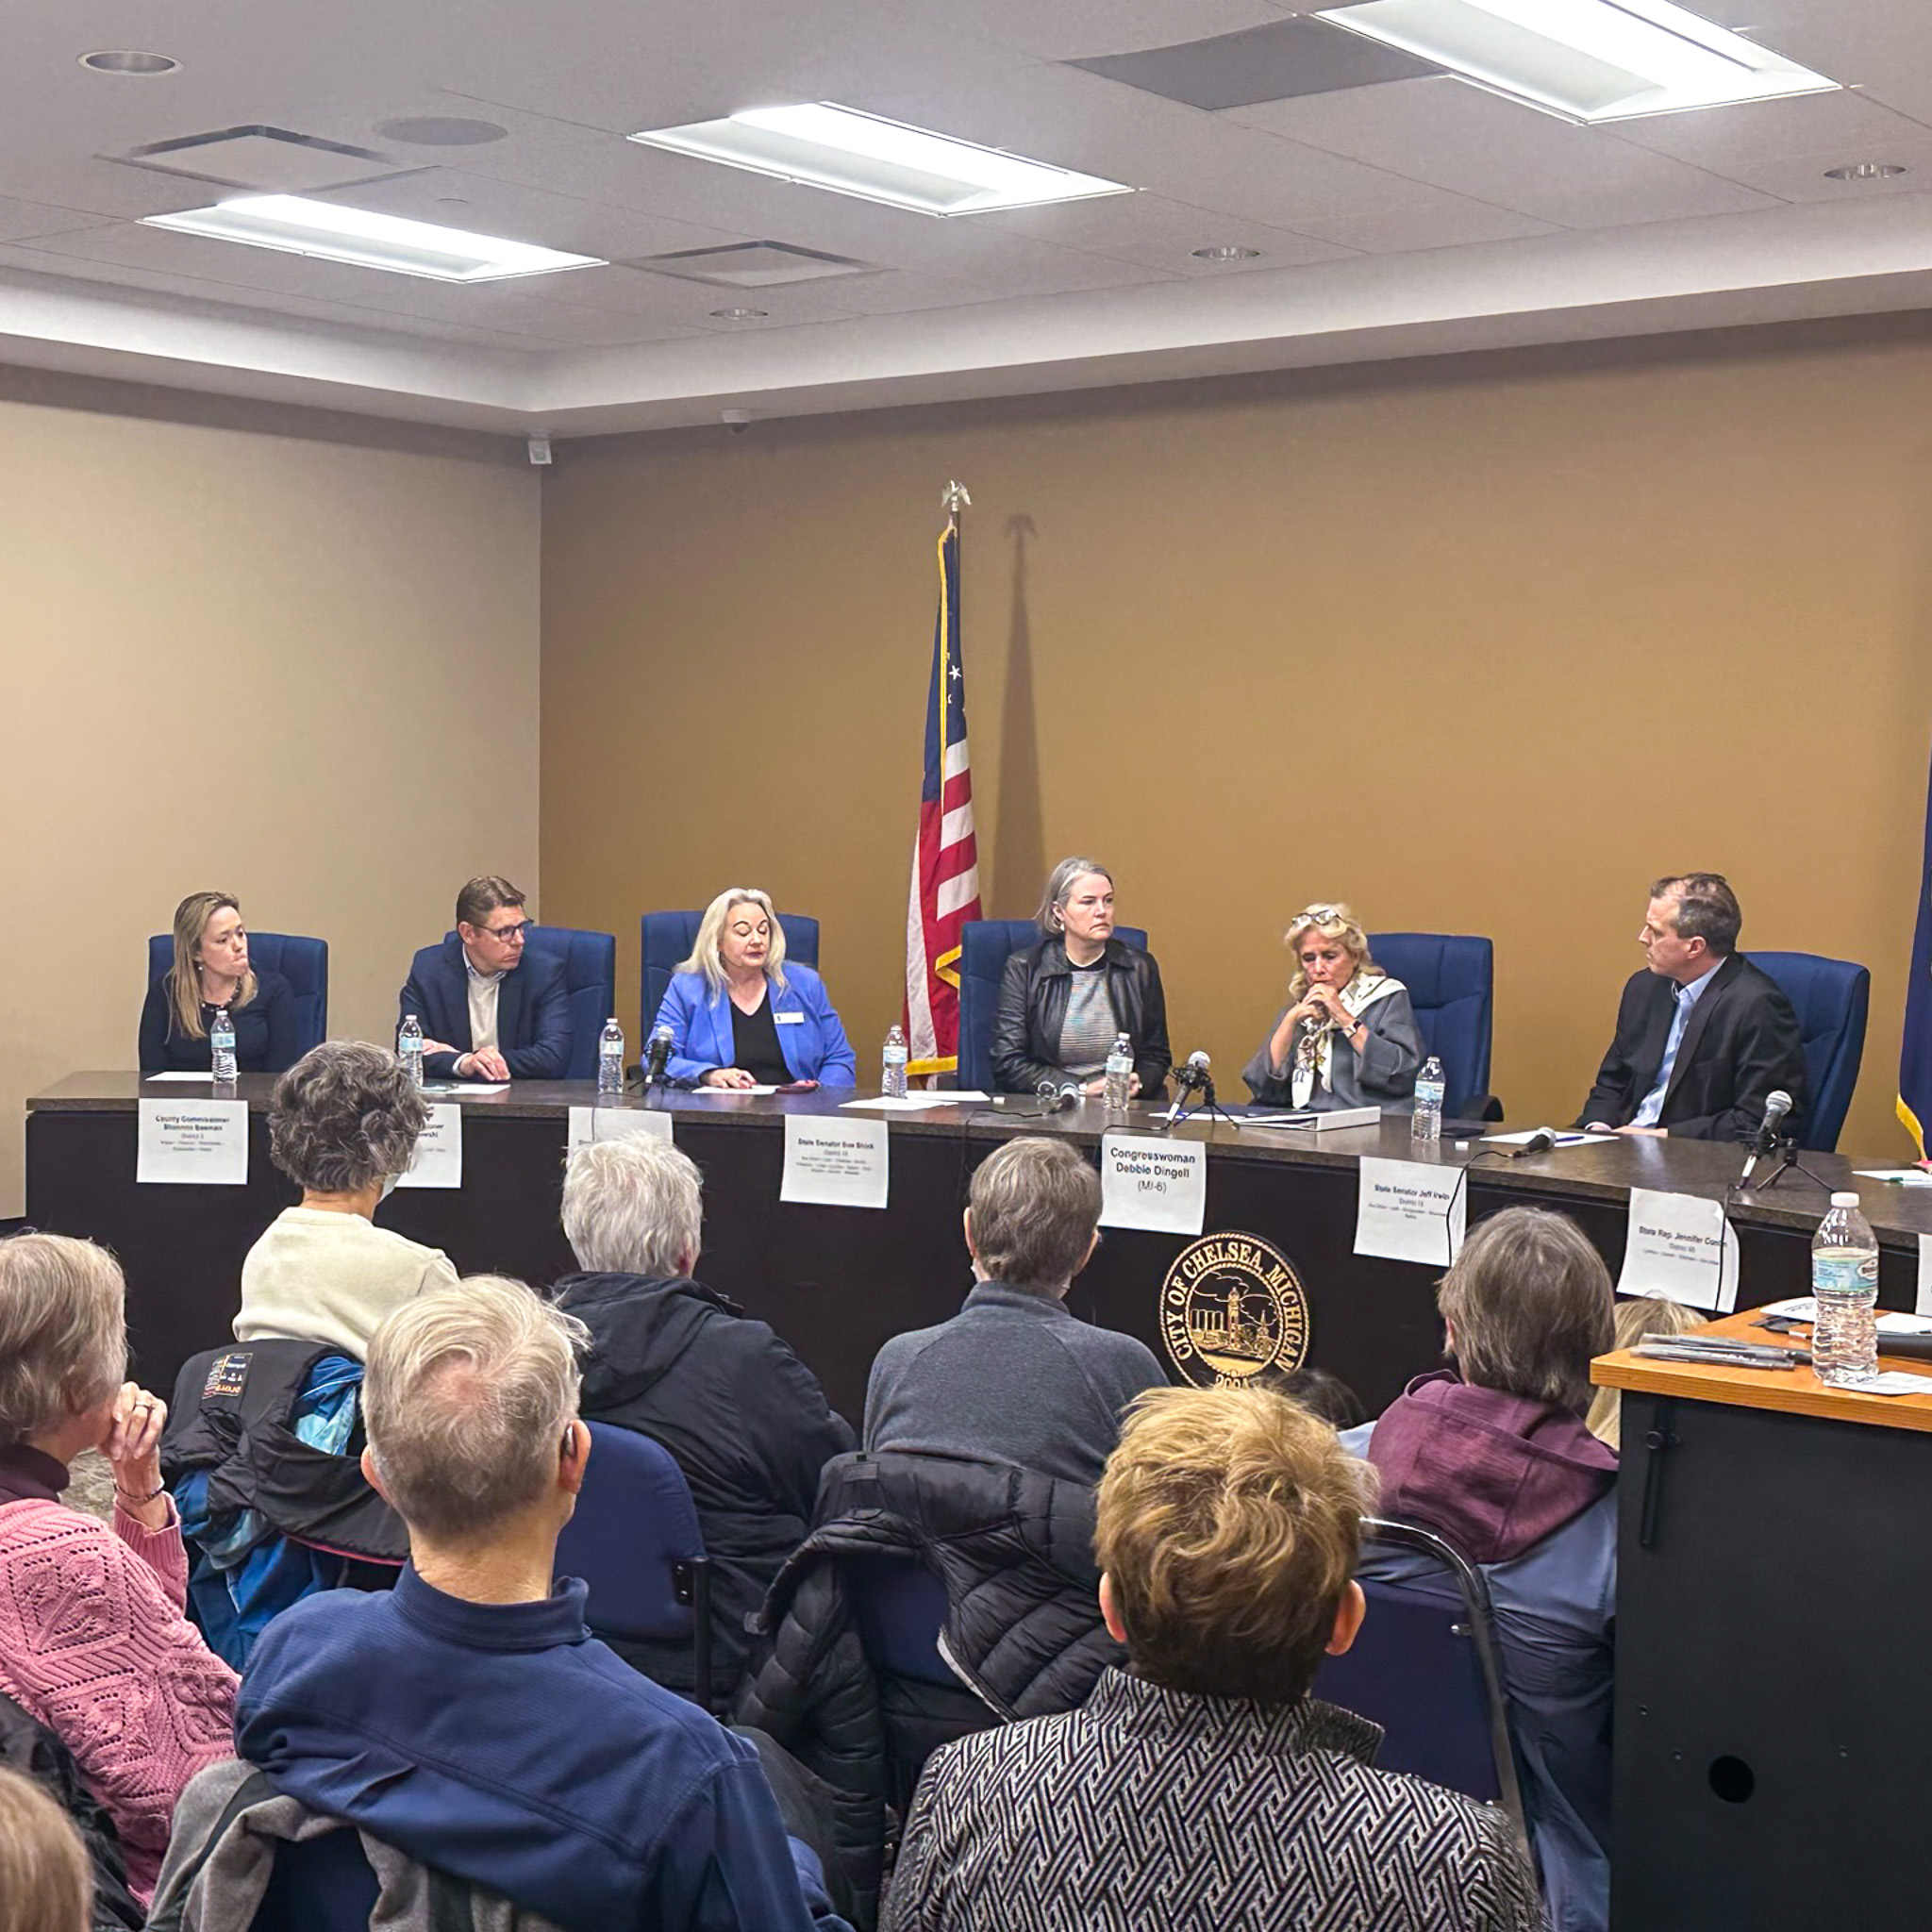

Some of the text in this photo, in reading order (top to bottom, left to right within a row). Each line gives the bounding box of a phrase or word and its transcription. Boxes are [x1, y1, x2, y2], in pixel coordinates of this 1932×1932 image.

[816, 1139, 841, 1147] Senator
[1110, 1147, 1195, 1163] Congresswoman
[1116, 1161, 1190, 1179] Debbie Dingell
[1138, 1180, 1167, 1194] (MI-6)
[1374, 1184, 1391, 1192] State
[1393, 1186, 1418, 1196] Senator
[1419, 1190, 1432, 1198] Jeff
[1674, 1232, 1703, 1243] Jennifer
[1166, 1241, 1303, 1374] CITY OF CHELSEA, MICHIGAN
